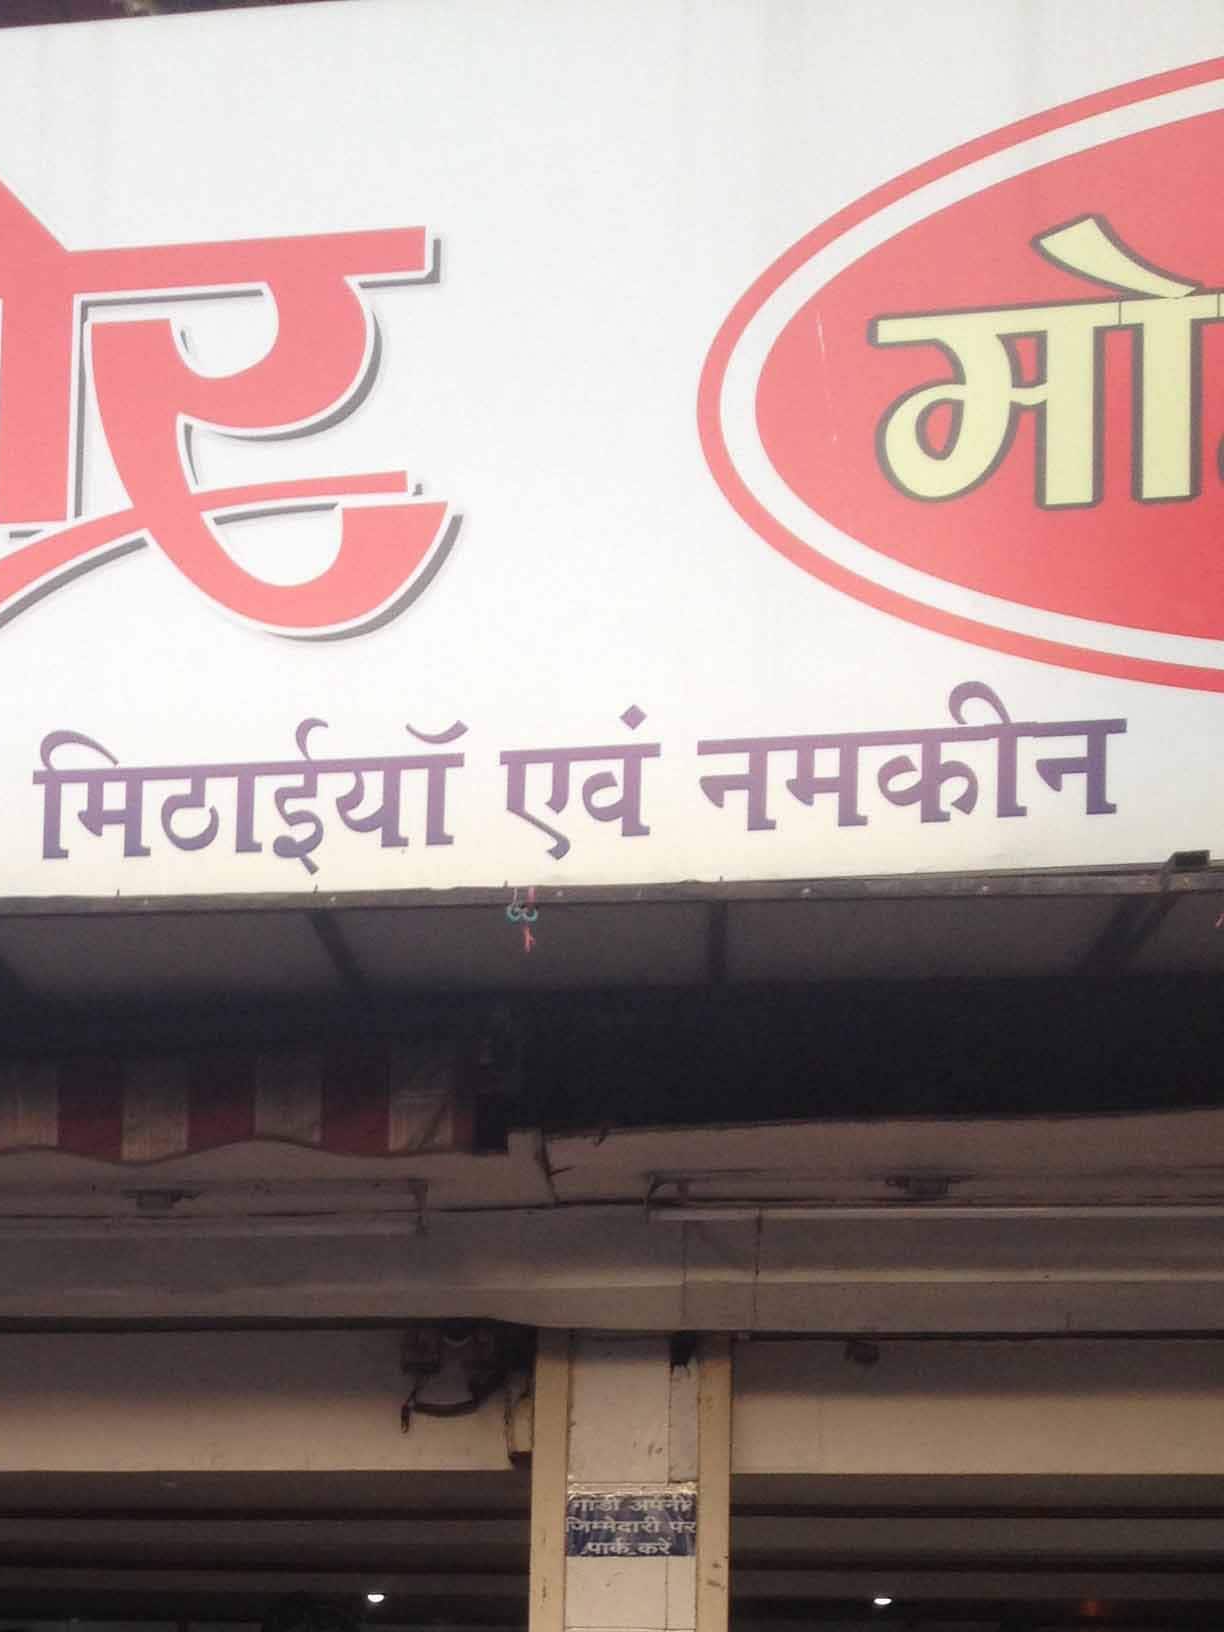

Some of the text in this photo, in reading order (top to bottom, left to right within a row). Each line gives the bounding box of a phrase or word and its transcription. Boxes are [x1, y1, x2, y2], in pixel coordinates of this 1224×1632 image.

[868, 212, 1224, 512] मो
[500, 703, 662, 862] एवं
[697, 680, 1129, 832] नमकीन
